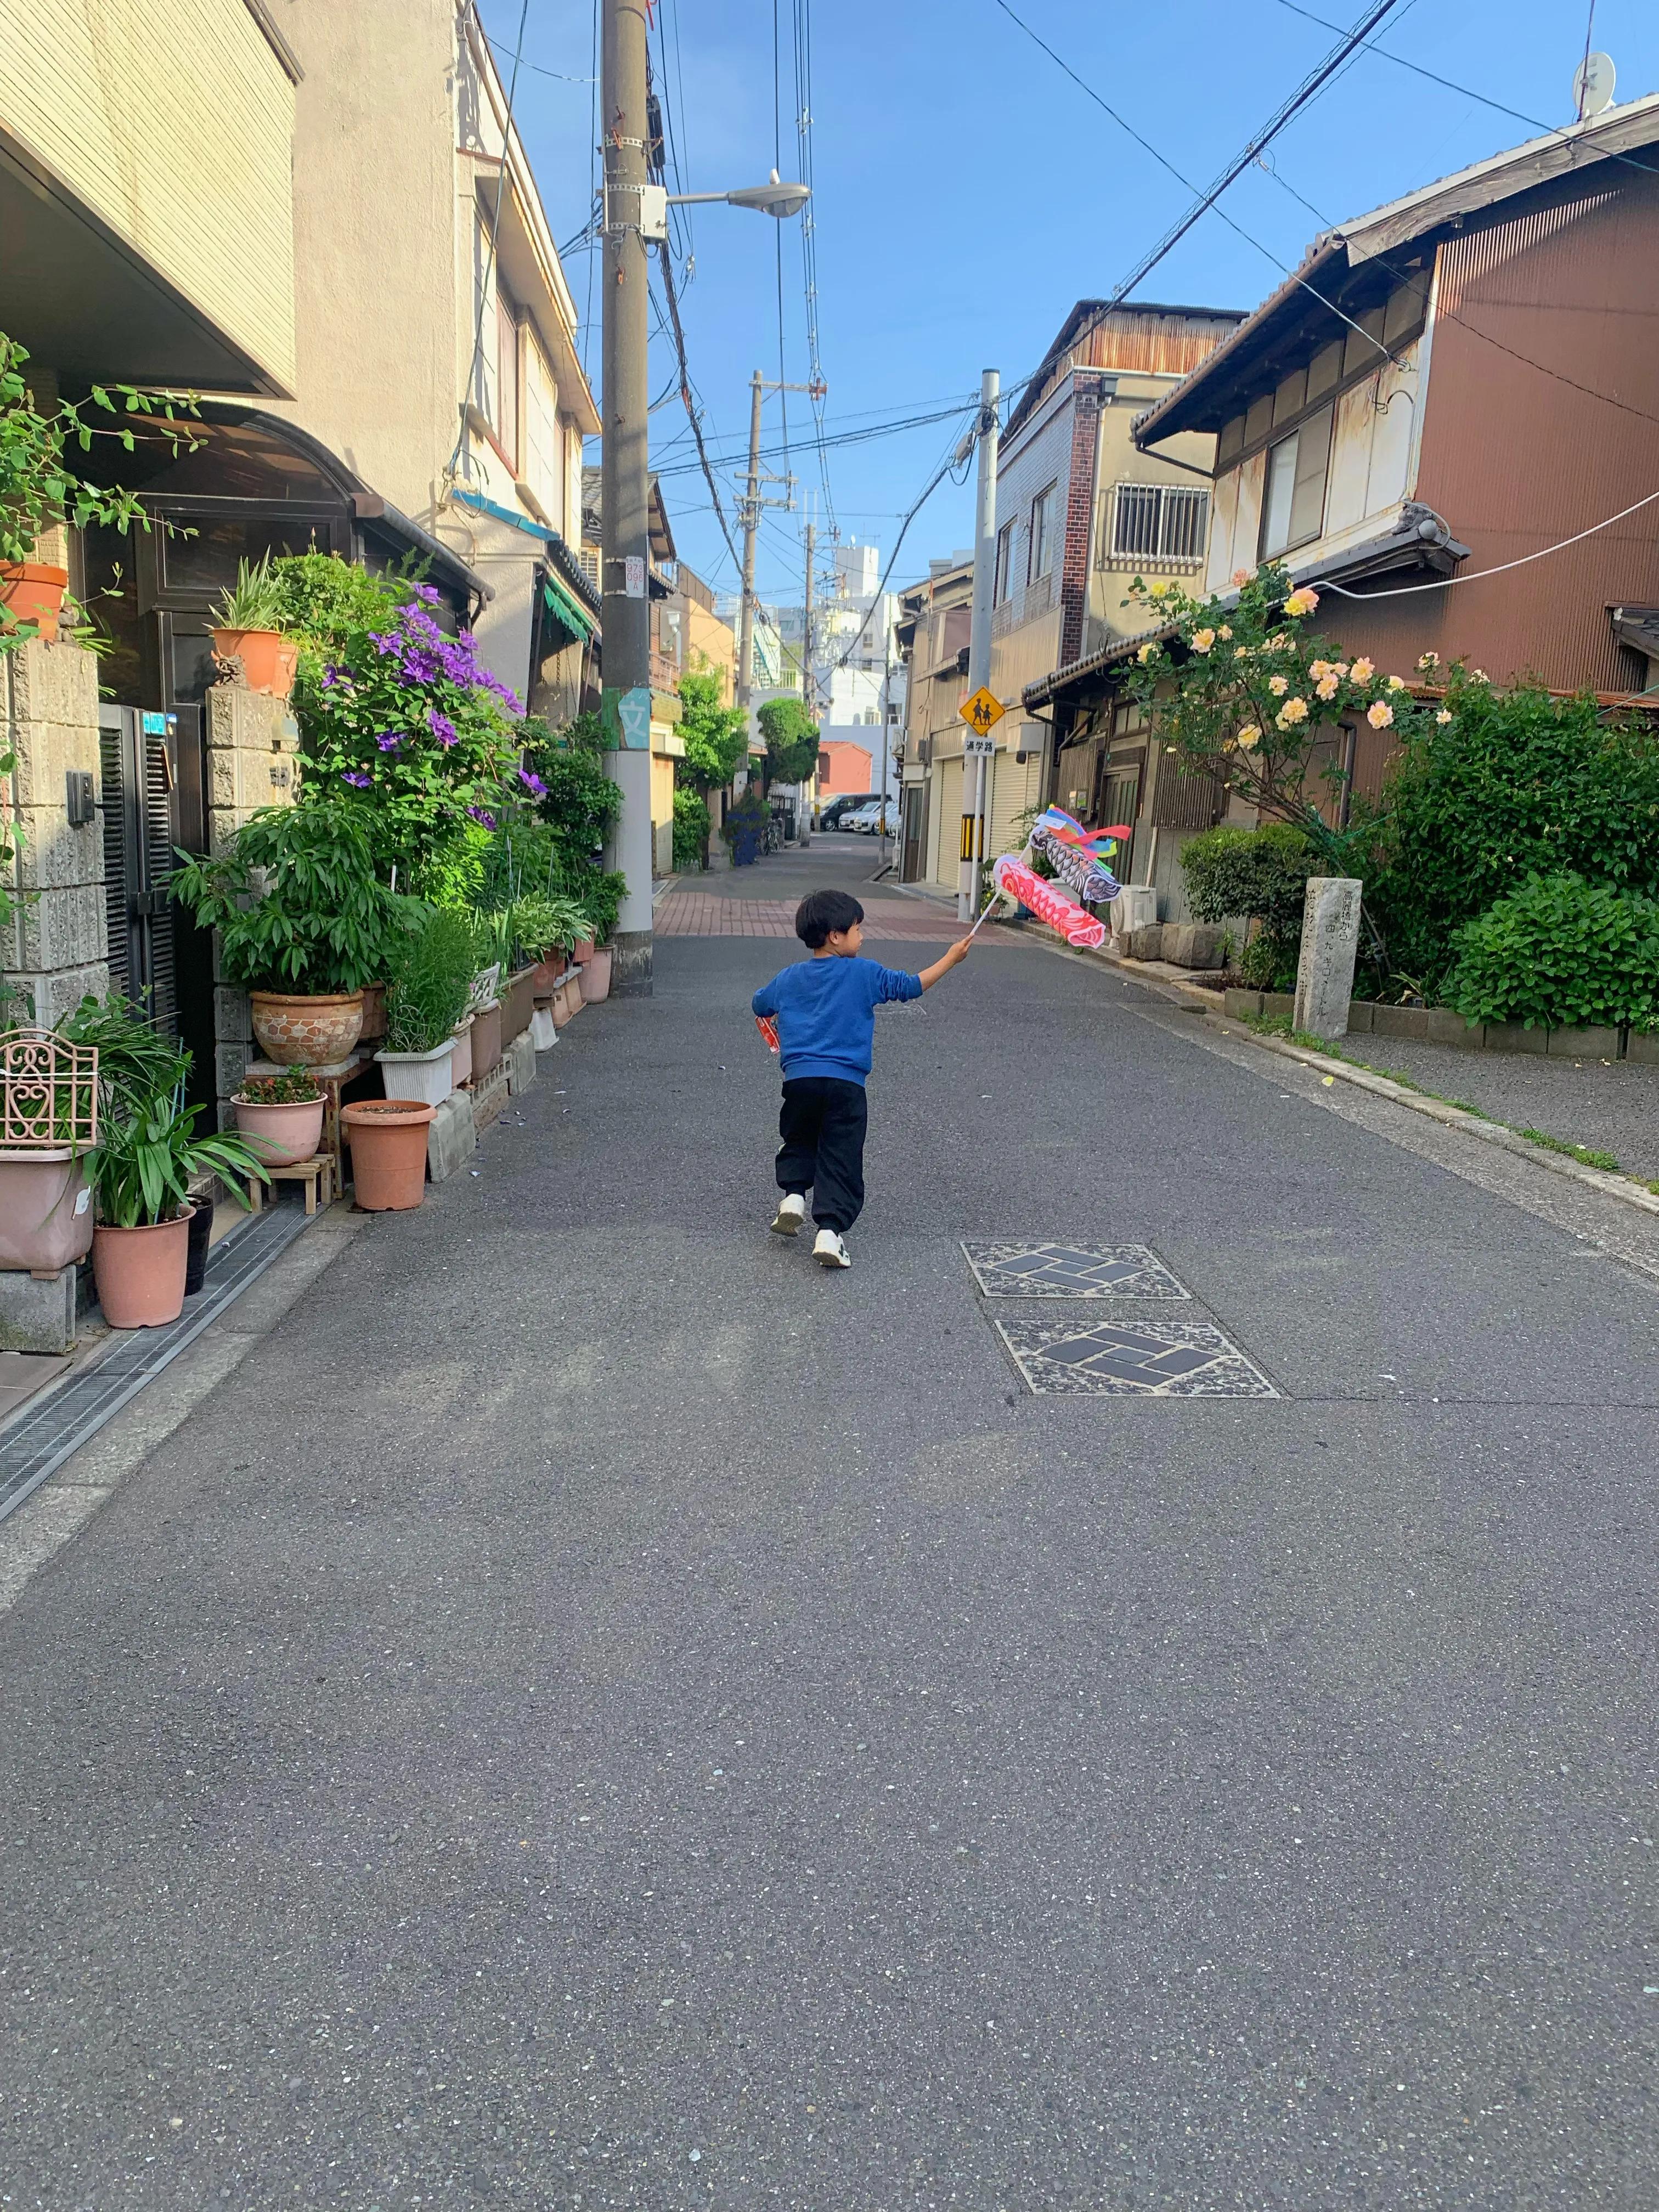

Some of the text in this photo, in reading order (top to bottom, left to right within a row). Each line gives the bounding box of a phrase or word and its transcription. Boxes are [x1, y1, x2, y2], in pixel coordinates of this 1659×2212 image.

[633, 582, 639, 590] A
[618, 701, 647, 738] 文
[966, 741, 992, 752] 通学路
[1339, 890, 1352, 941] 高麗橋から
